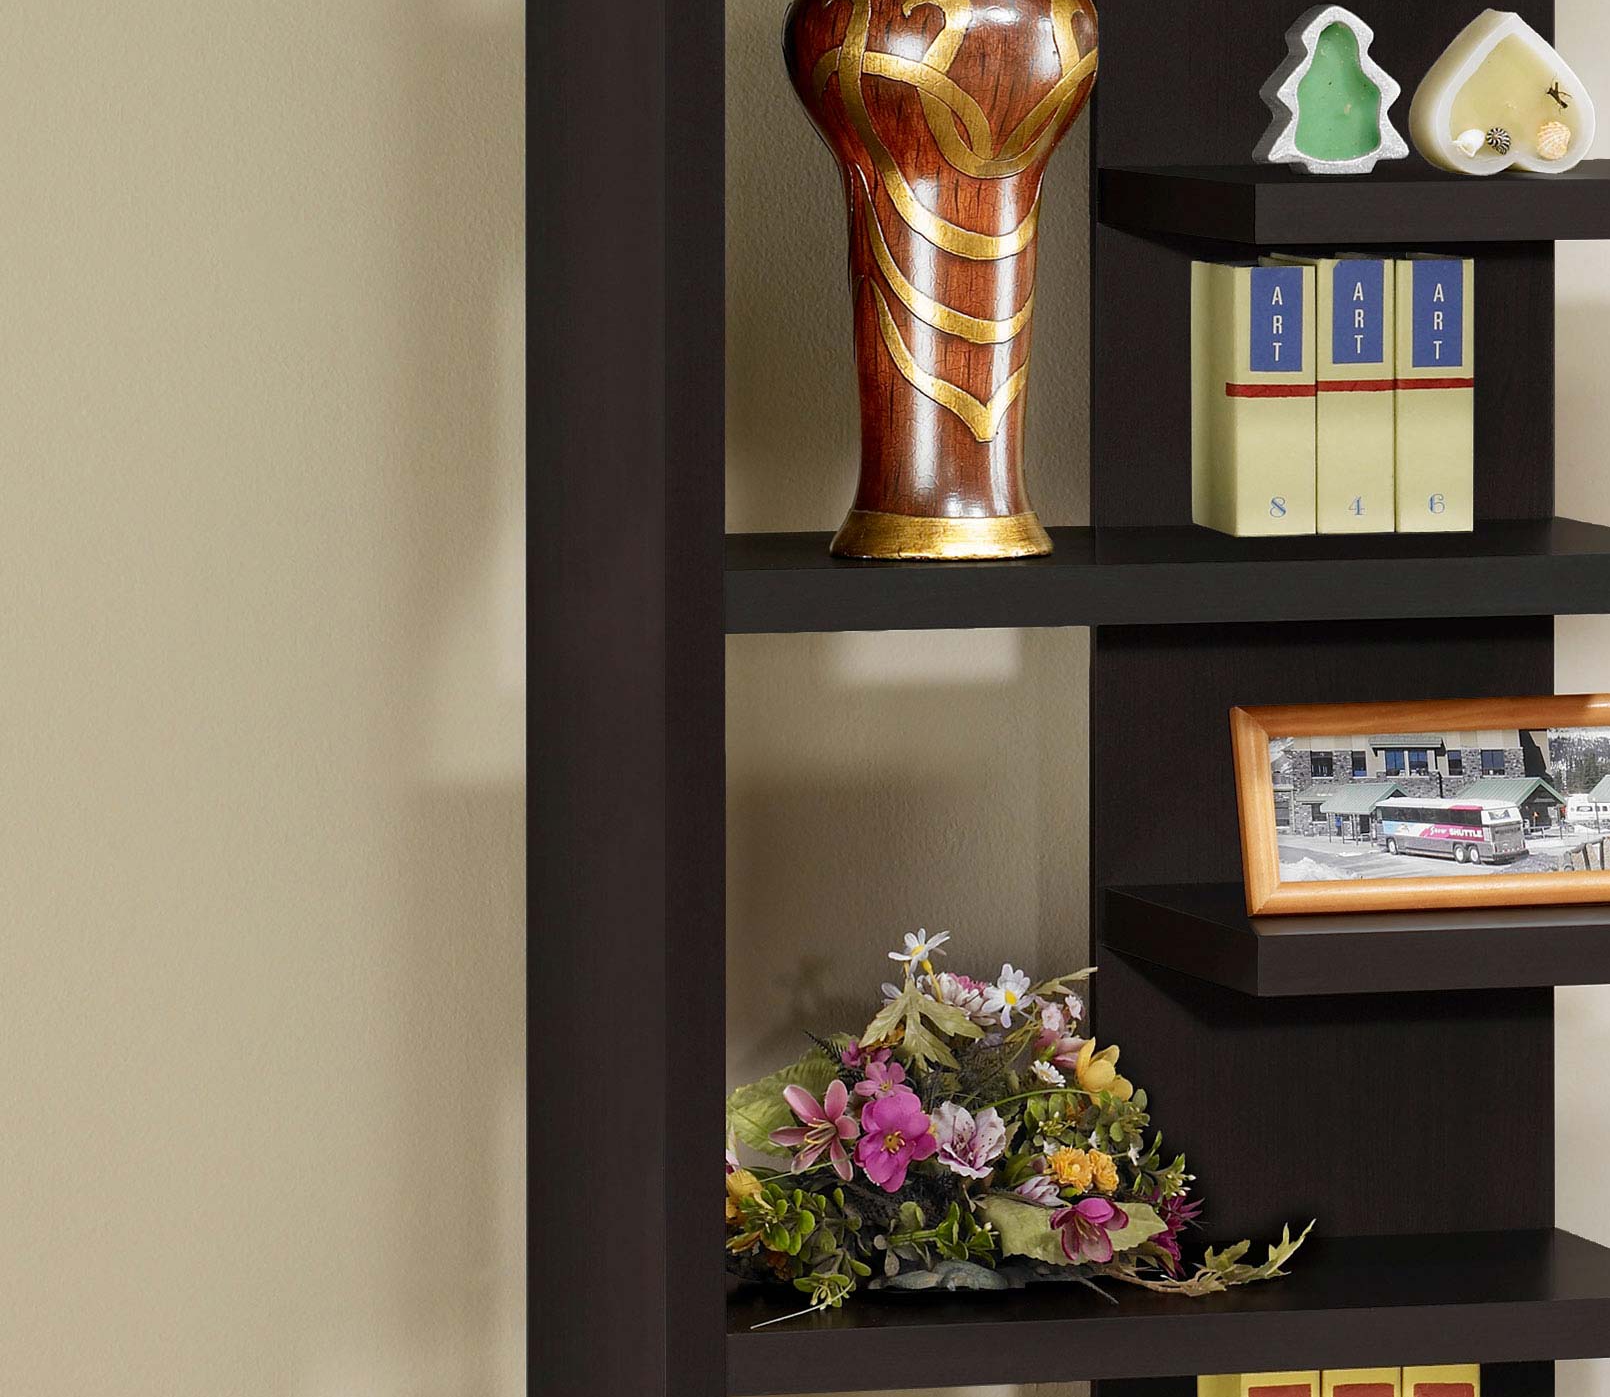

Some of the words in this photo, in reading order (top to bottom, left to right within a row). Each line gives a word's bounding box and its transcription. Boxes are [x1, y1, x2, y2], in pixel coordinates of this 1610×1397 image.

[1271, 286, 1283, 361] ART
[1353, 282, 1364, 354] ART
[1433, 283, 1444, 360] ART
[1269, 496, 1287, 518] 8
[1348, 496, 1365, 516] 4
[1428, 493, 1446, 514] 6
[1450, 828, 1483, 837] SHUTTLE
